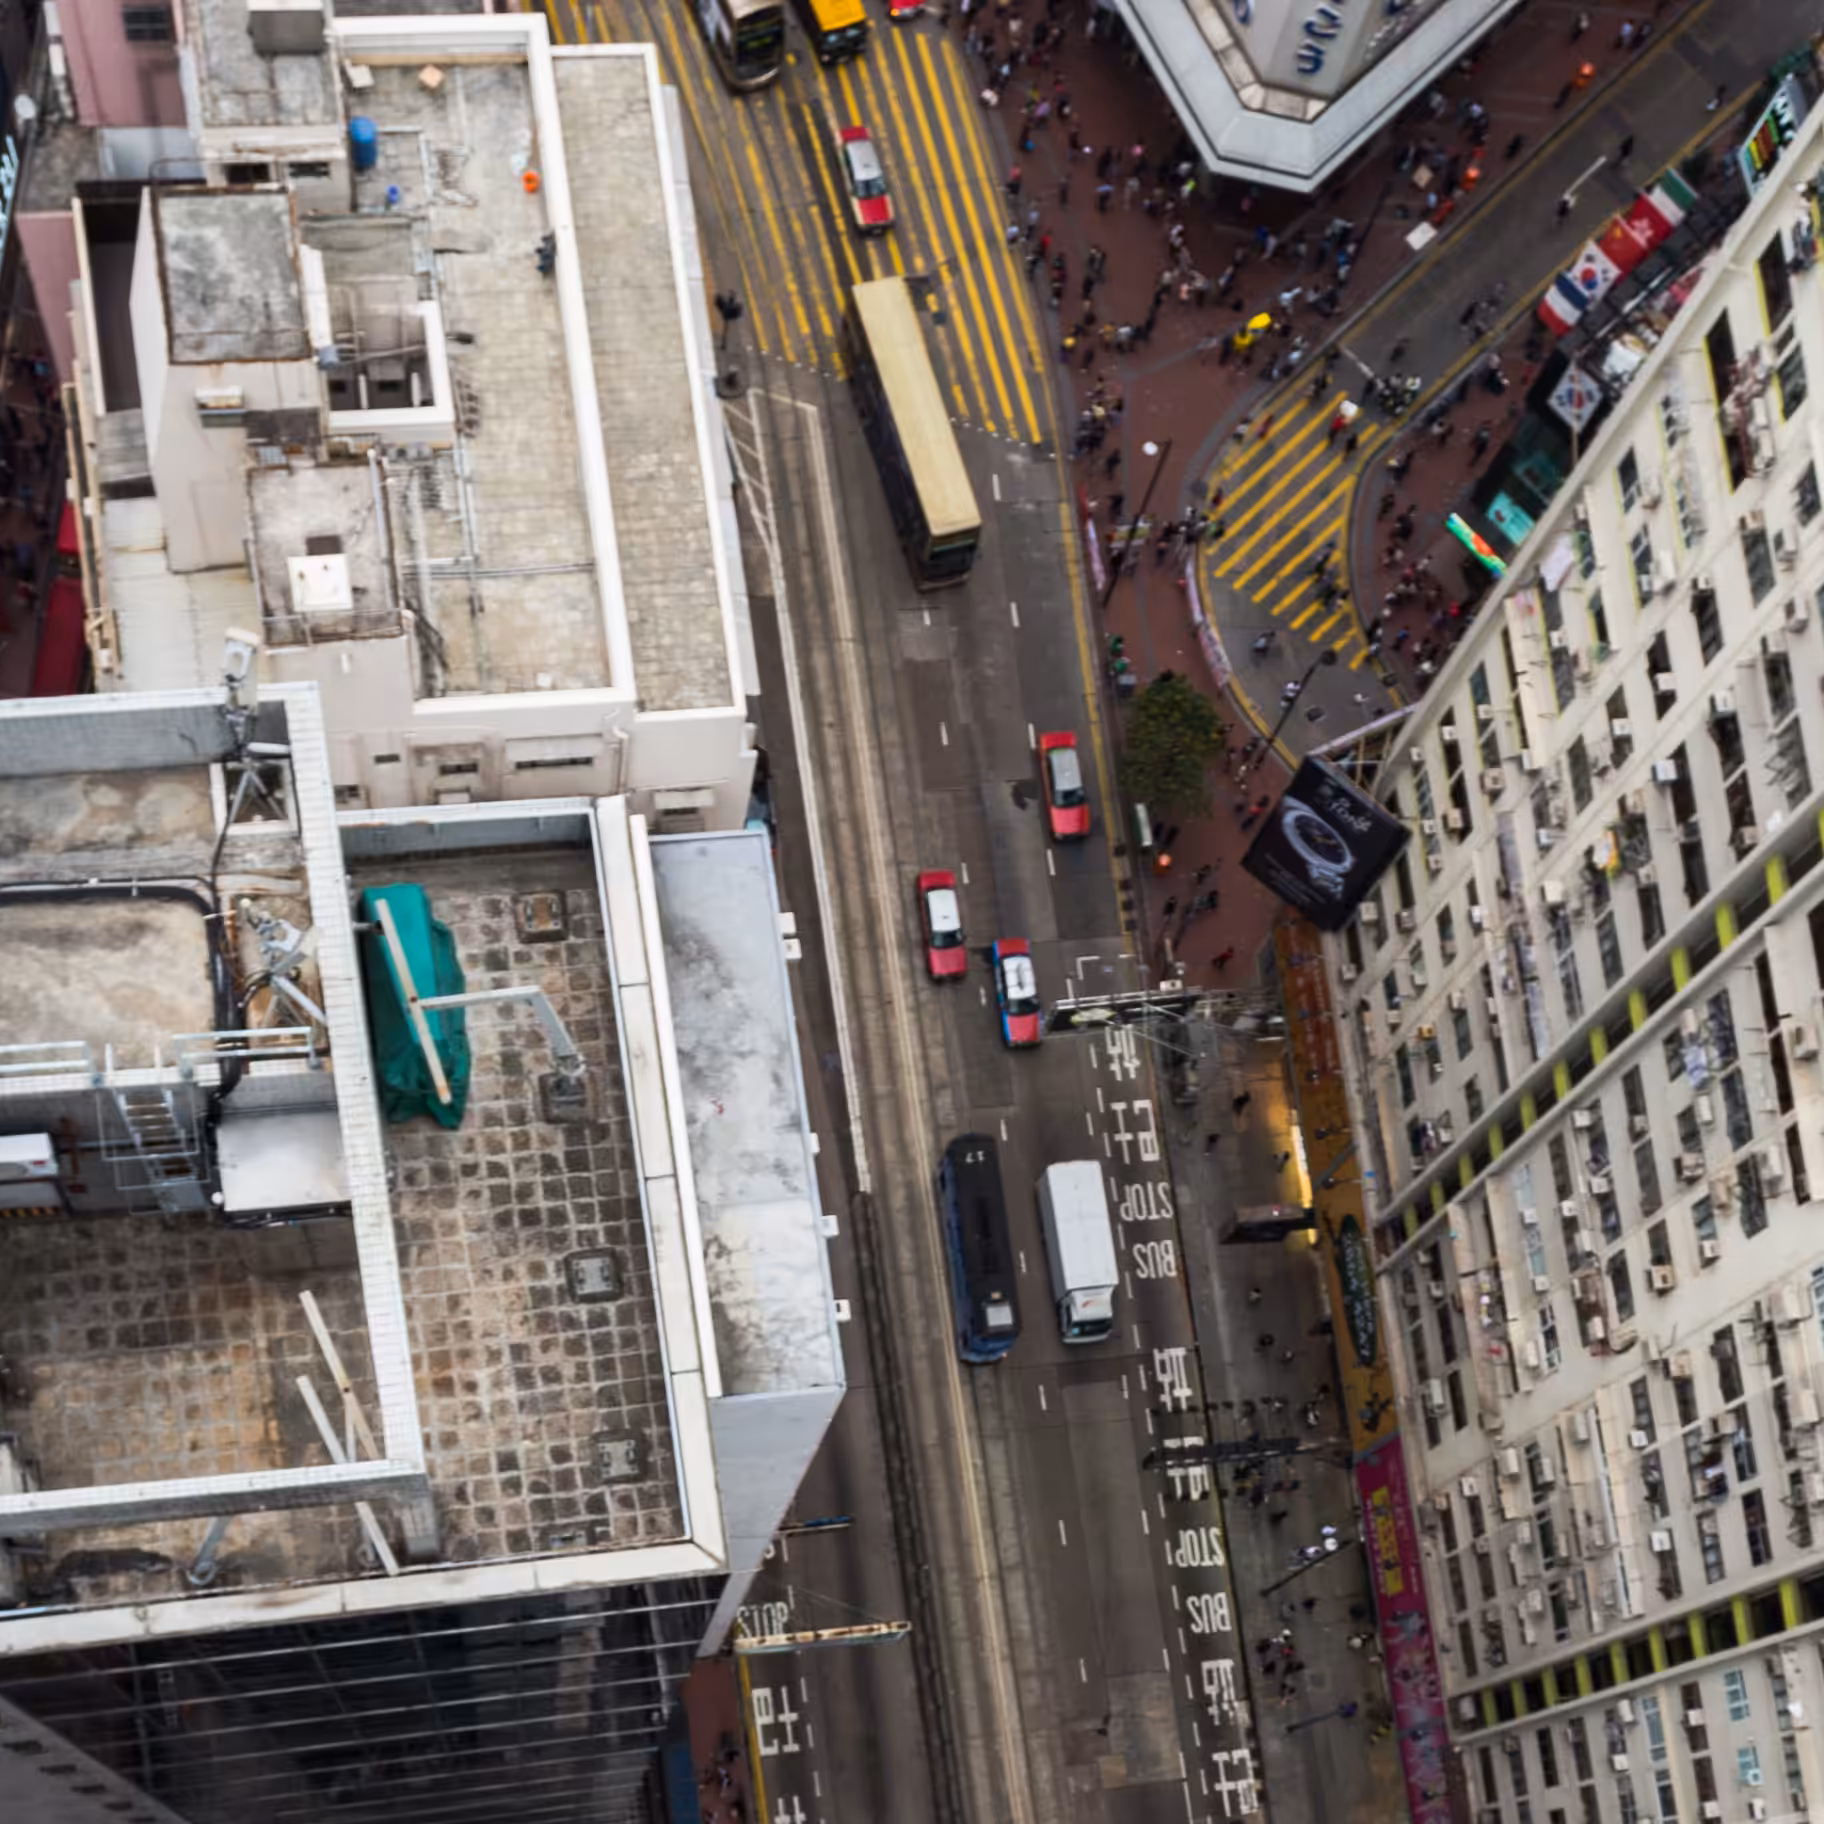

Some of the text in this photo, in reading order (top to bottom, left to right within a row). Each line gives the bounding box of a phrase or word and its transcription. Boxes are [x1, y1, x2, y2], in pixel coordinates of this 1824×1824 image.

[1105, 1024, 1141, 1081] 站
[1110, 1099, 1160, 1164] 巴士
[964, 1150, 984, 1164] 17
[1120, 1181, 1173, 1221] STOP
[1133, 1239, 1177, 1278] BUS
[1153, 1348, 1193, 1412] 站
[1176, 1527, 1225, 1567] STOP
[736, 1601, 789, 1639] STOP
[1186, 1592, 1232, 1633] BUS
[1201, 1659, 1240, 1725] 站
[752, 1686, 800, 1757] 巴士
[1212, 1749, 1259, 1817] 巴士
